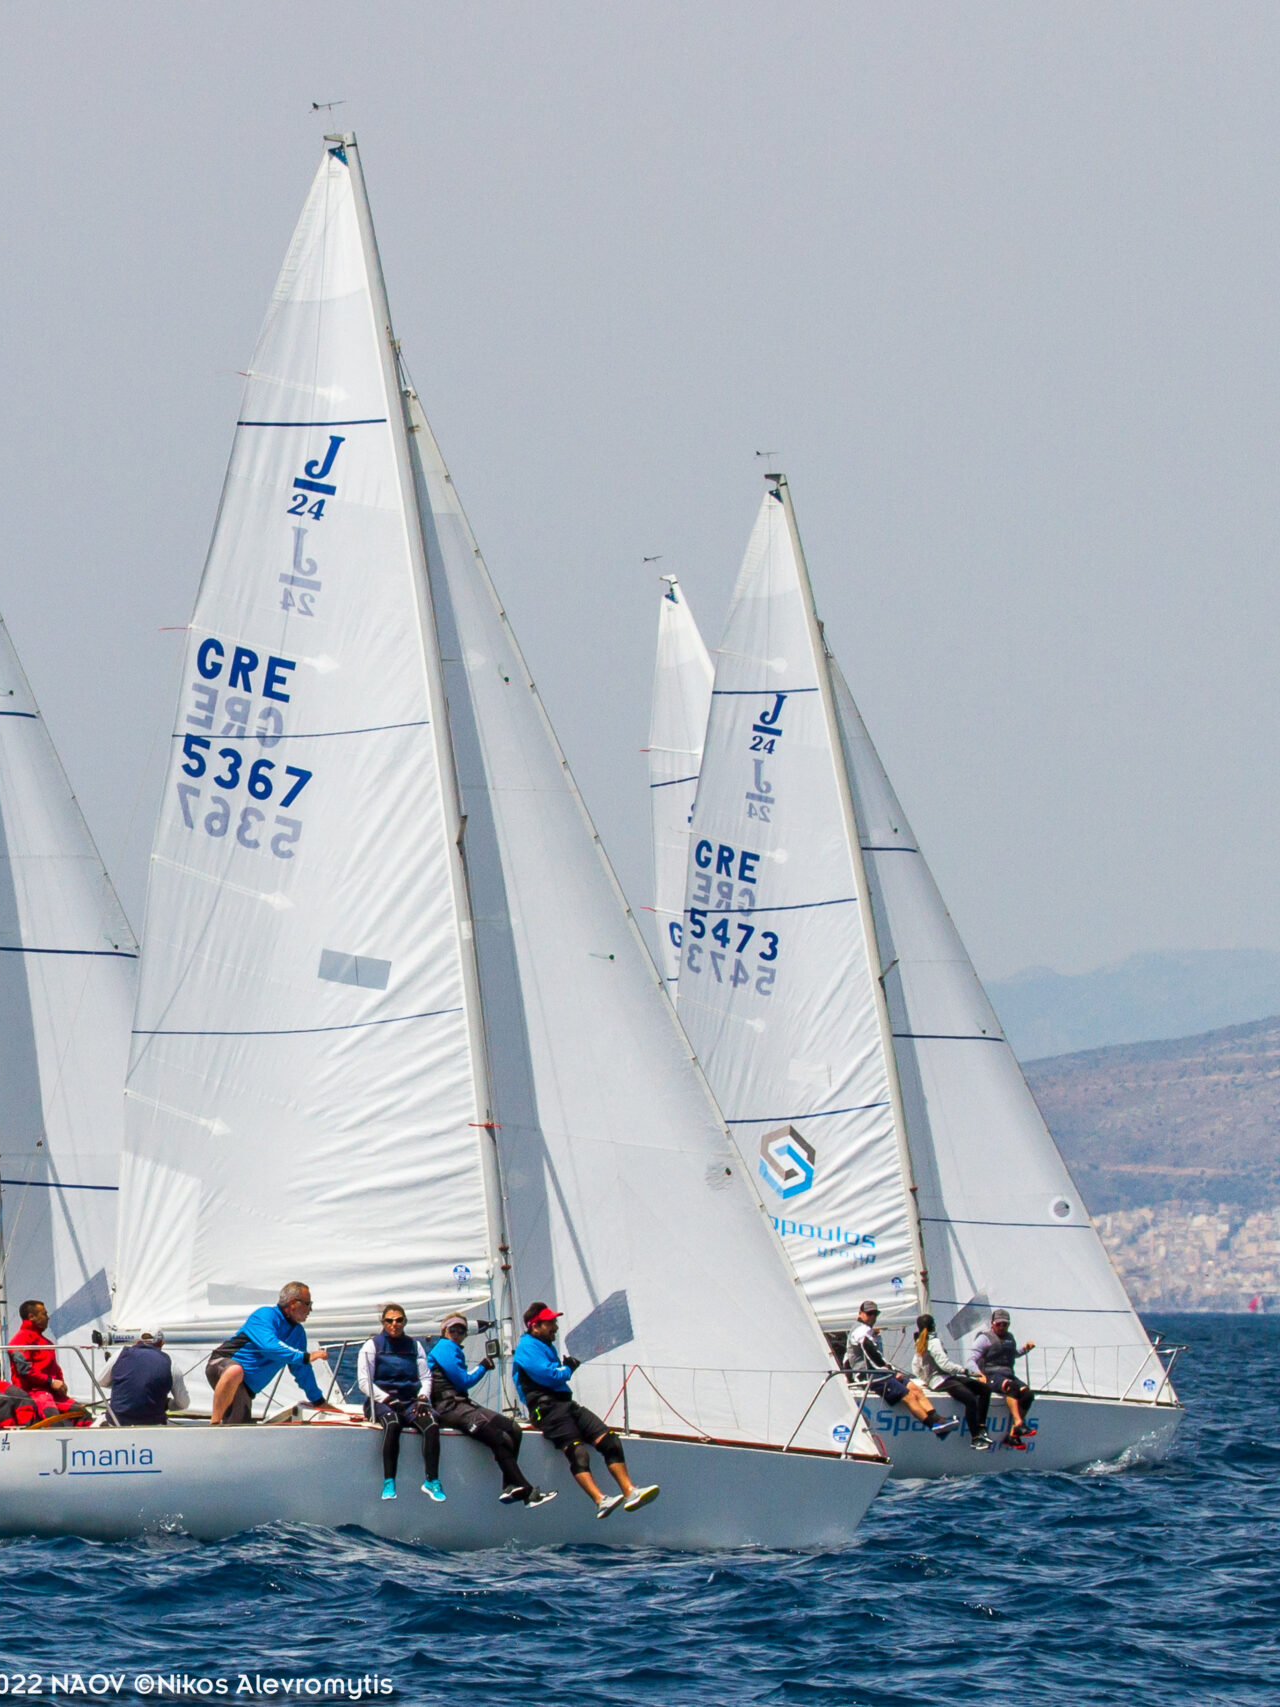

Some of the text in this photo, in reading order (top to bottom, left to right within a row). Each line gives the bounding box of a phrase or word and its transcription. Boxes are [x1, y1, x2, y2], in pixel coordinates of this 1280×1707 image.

[304, 435, 346, 479] J
[287, 493, 326, 521] 24
[196, 637, 296, 703] GRE
[759, 693, 787, 725] J
[749, 735, 775, 755] 24
[181, 733, 313, 808] 5367
[695, 840, 760, 884] GRE
[689, 907, 779, 961] 5473
[53, 1438, 153, 1475] Jmania
